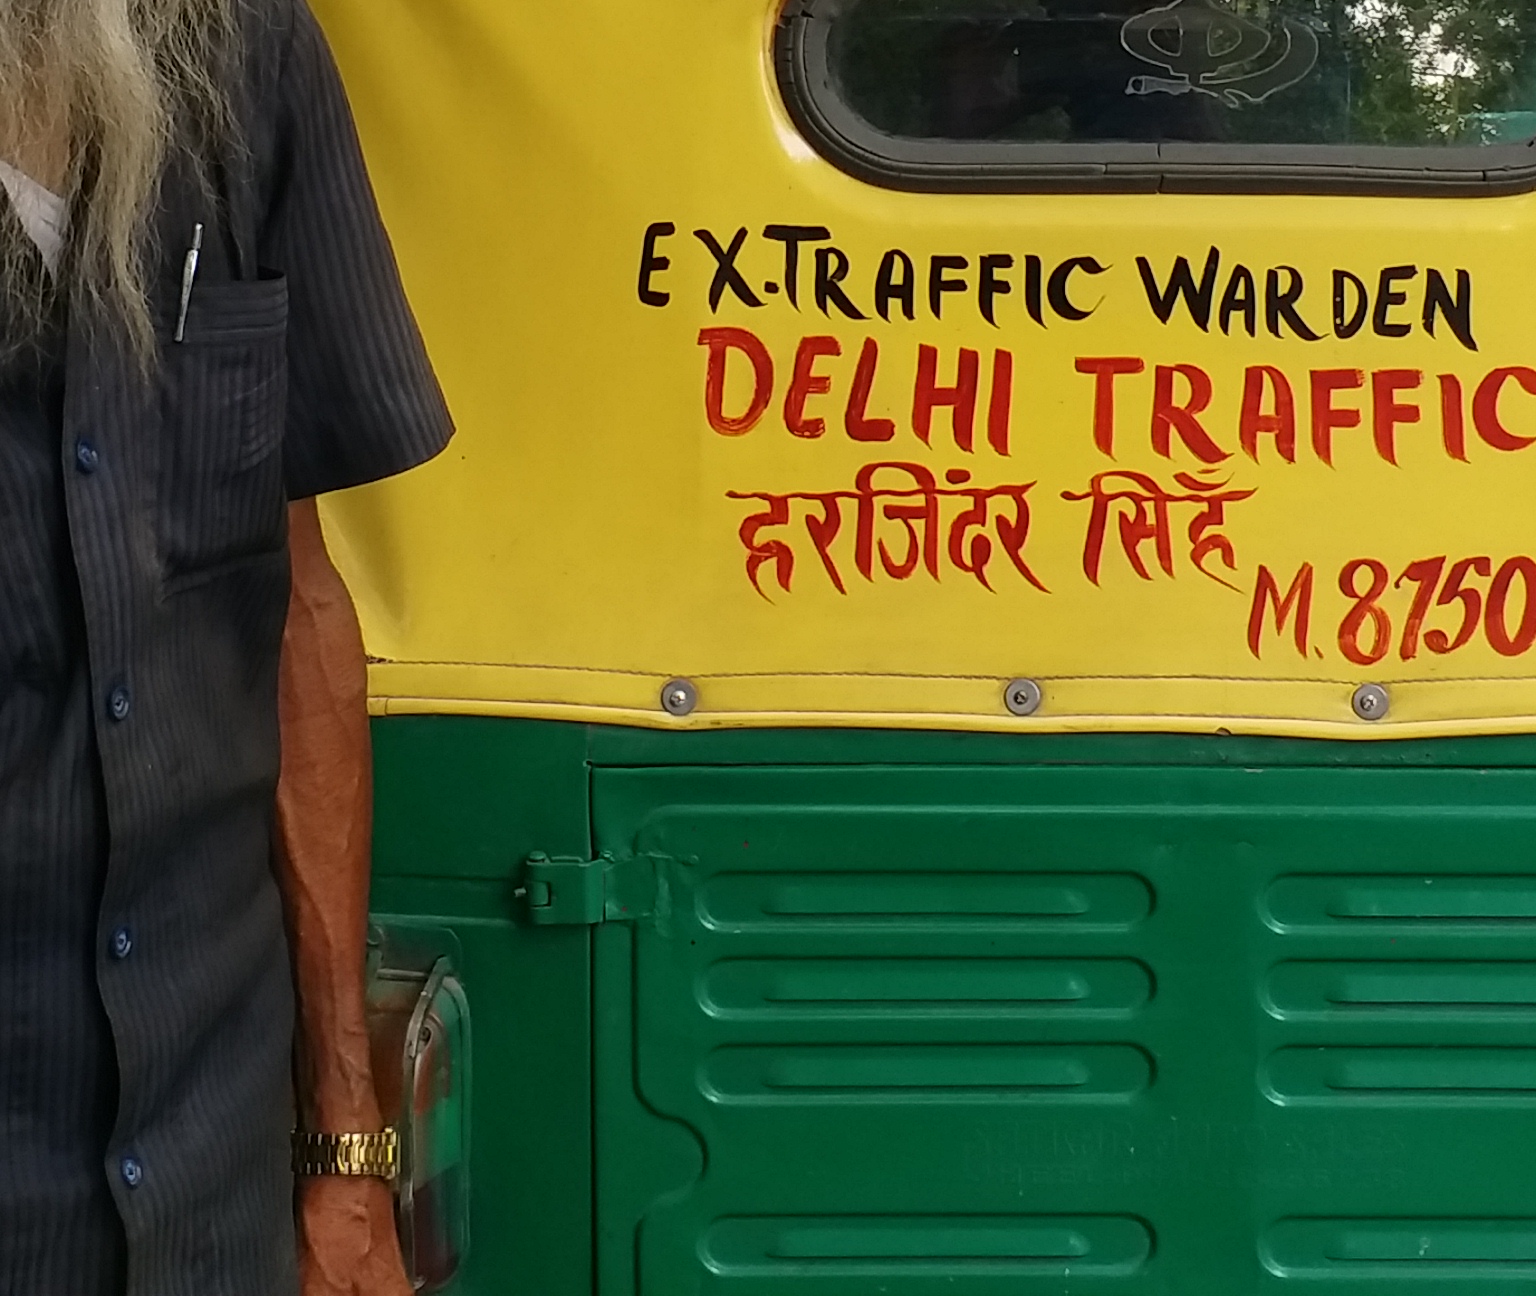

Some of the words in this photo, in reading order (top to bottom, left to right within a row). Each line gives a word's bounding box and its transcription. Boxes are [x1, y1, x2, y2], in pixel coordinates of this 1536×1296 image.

[1136, 246, 1477, 351] WARDEN
[697, 325, 1014, 456] DELHI
[725, 460, 1052, 605] हरजिंदर
